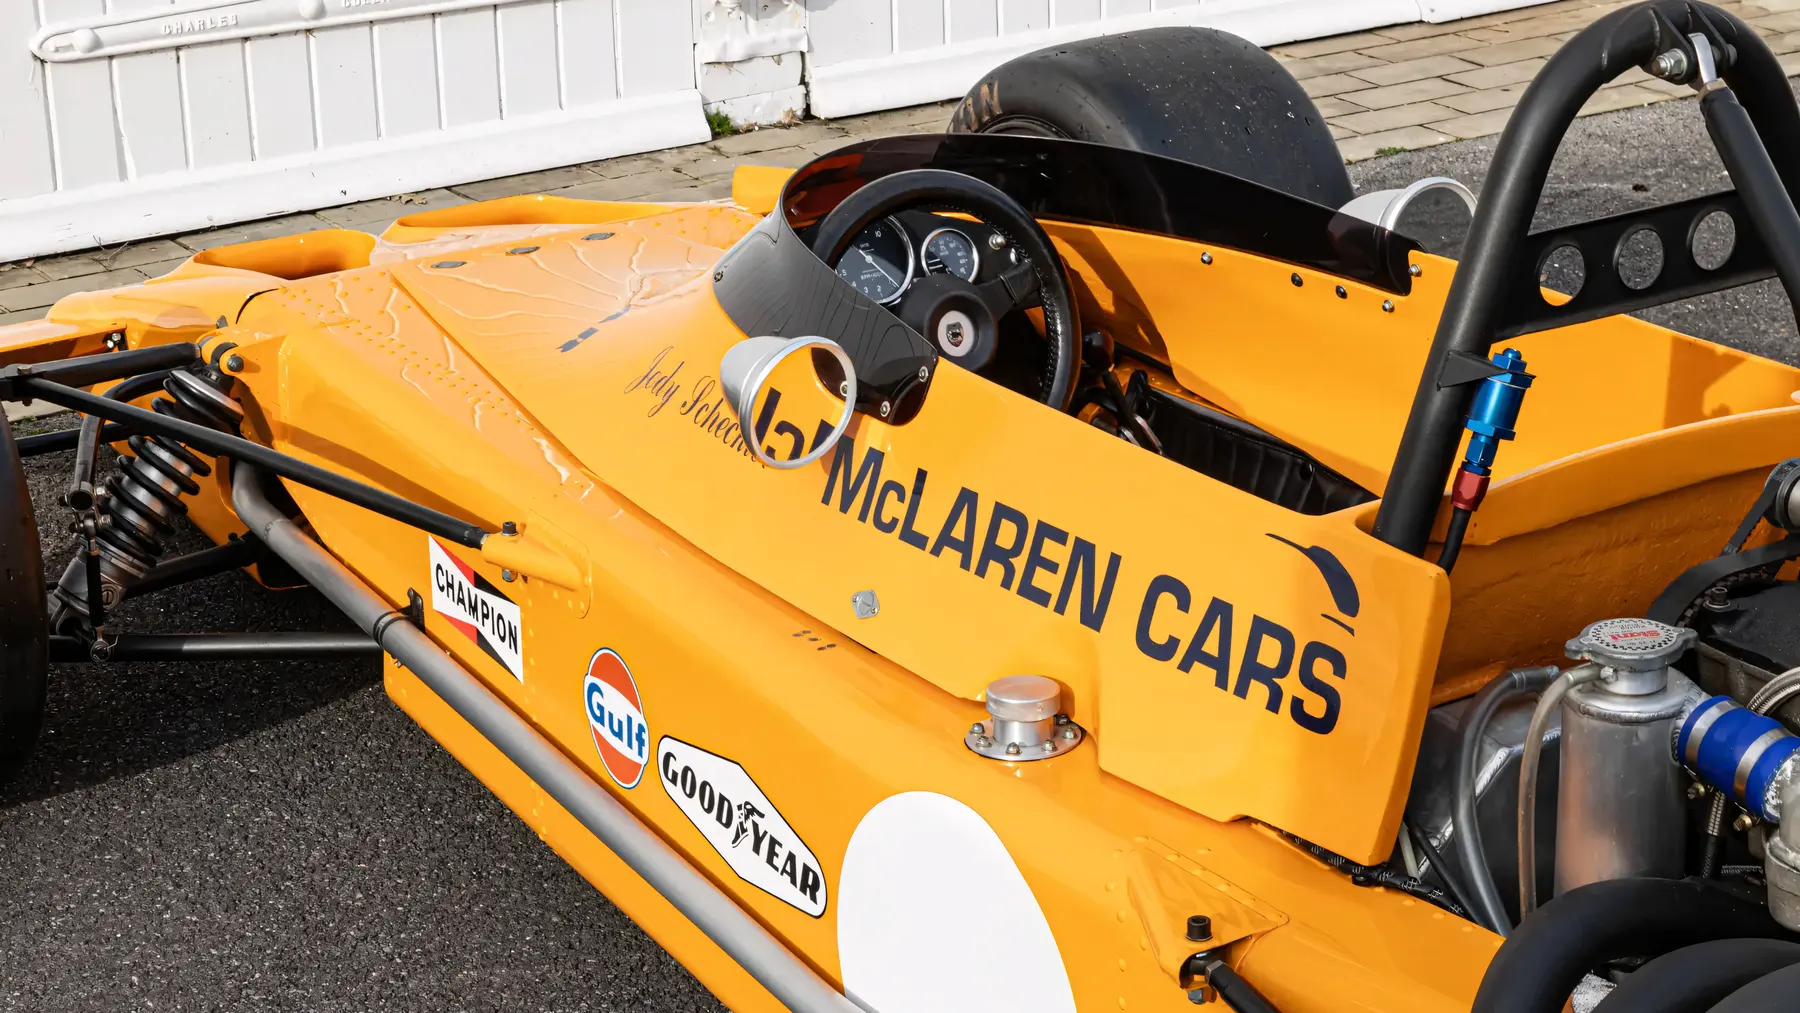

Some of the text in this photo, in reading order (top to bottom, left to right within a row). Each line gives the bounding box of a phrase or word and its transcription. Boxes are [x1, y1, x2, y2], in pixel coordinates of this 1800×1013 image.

[624, 345, 684, 418] Jody
[436, 563, 518, 655] CHAMPION
[821, 434, 1347, 735] McLAREN CARS
[587, 682, 646, 758] Gulf
